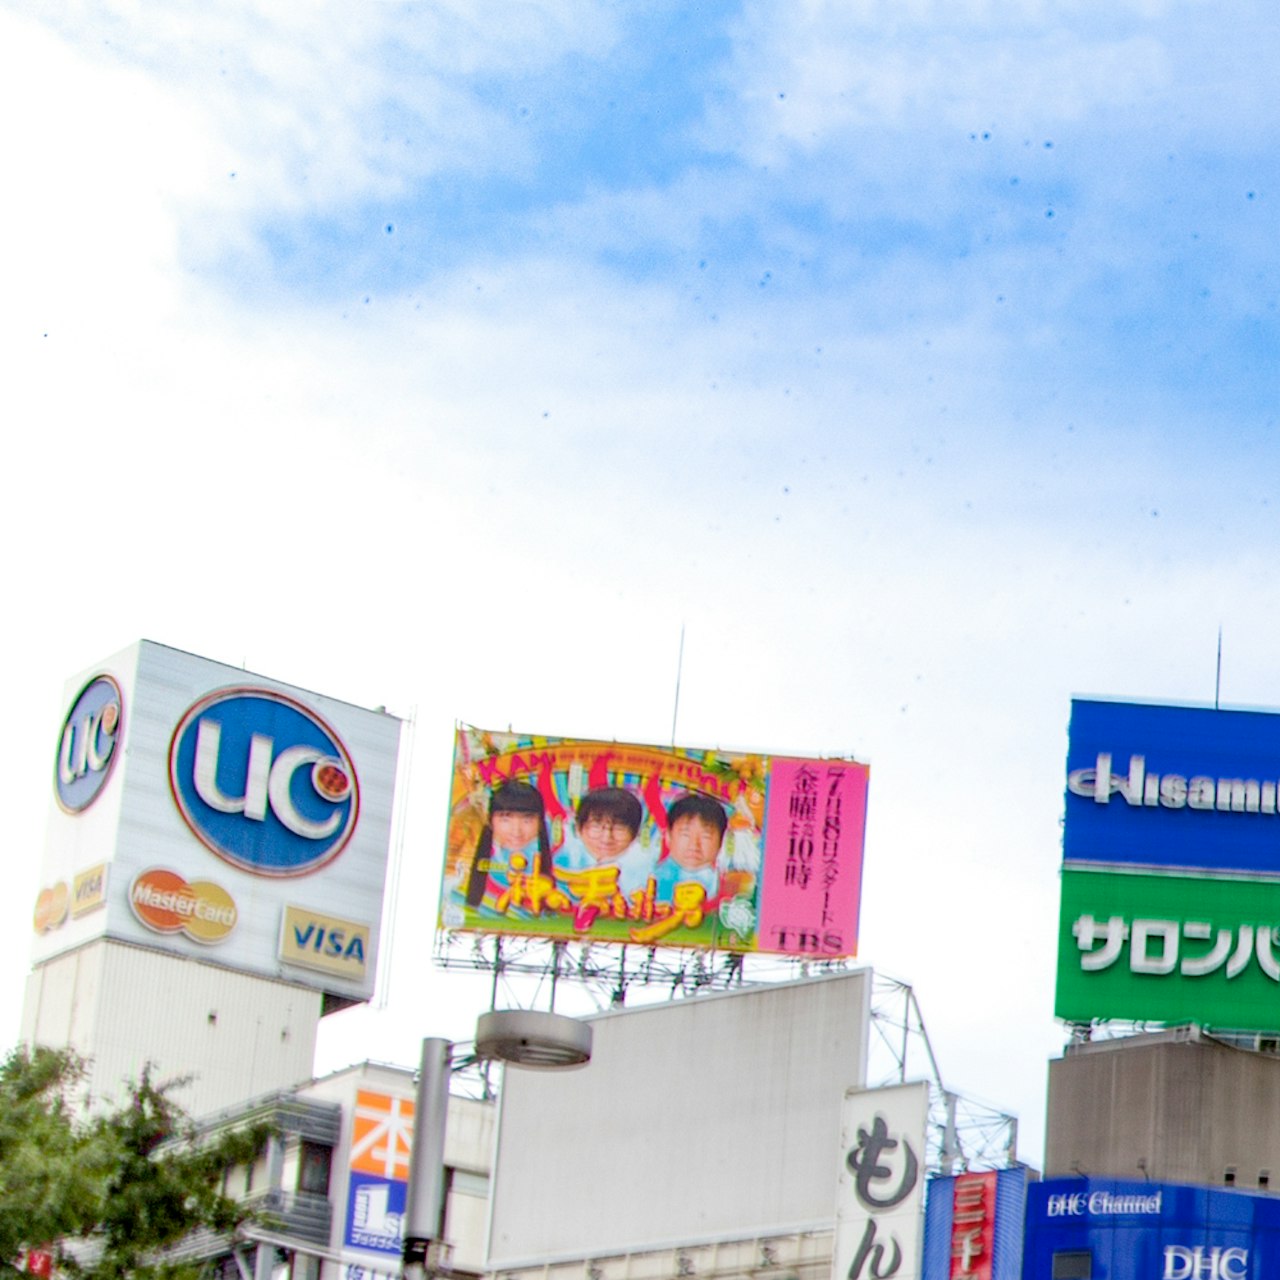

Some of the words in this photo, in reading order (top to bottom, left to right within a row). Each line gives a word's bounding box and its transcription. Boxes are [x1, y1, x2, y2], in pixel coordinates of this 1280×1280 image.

[194, 718, 350, 840] UC
[133, 881, 236, 926] MasterCard
[294, 922, 365, 964] VISA
[772, 926, 843, 953] TBS
[1048, 1193, 1085, 1217] DHC
[1088, 1192, 1162, 1215] Channel
